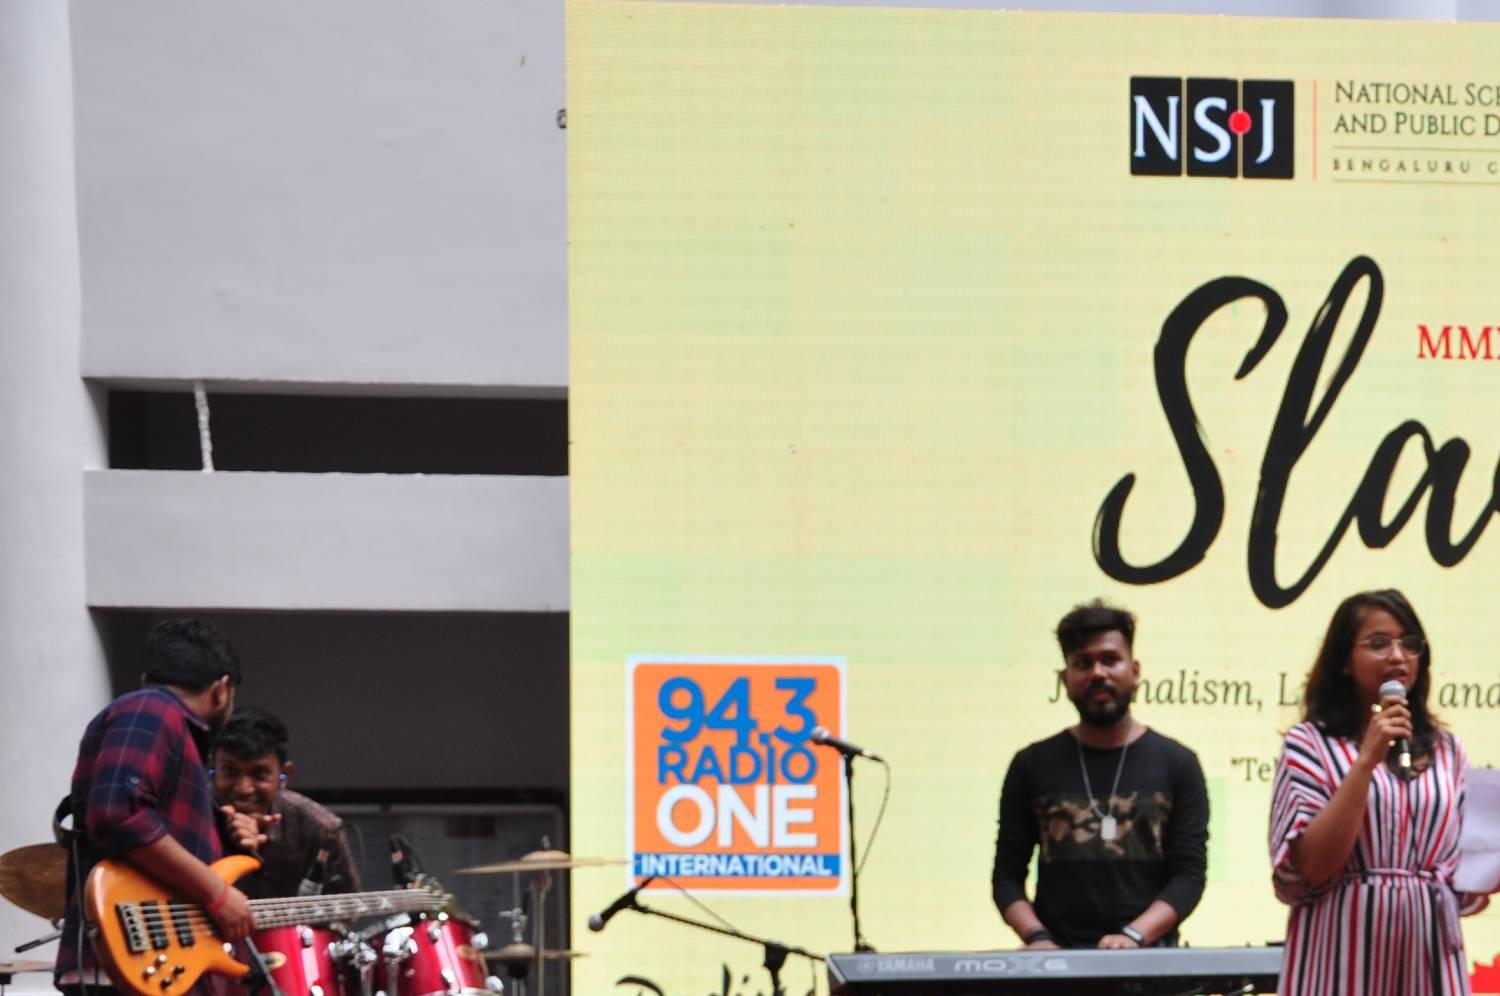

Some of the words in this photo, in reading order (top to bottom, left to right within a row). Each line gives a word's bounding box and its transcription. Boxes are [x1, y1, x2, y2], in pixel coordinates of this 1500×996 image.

[1335, 81, 1457, 106] NATIONAL
[1334, 113, 1386, 135] AND
[1395, 112, 1476, 136] PUBLIC
[1333, 159, 1471, 174] BENGALURU
[1048, 670, 1263, 711] Jnalism,
[657, 676, 818, 748] 94.3
[657, 744, 818, 785] RADIO
[656, 783, 818, 848] ONE
[640, 854, 832, 877] INTERNATIONAL
[878, 958, 936, 973] YAMAHA
